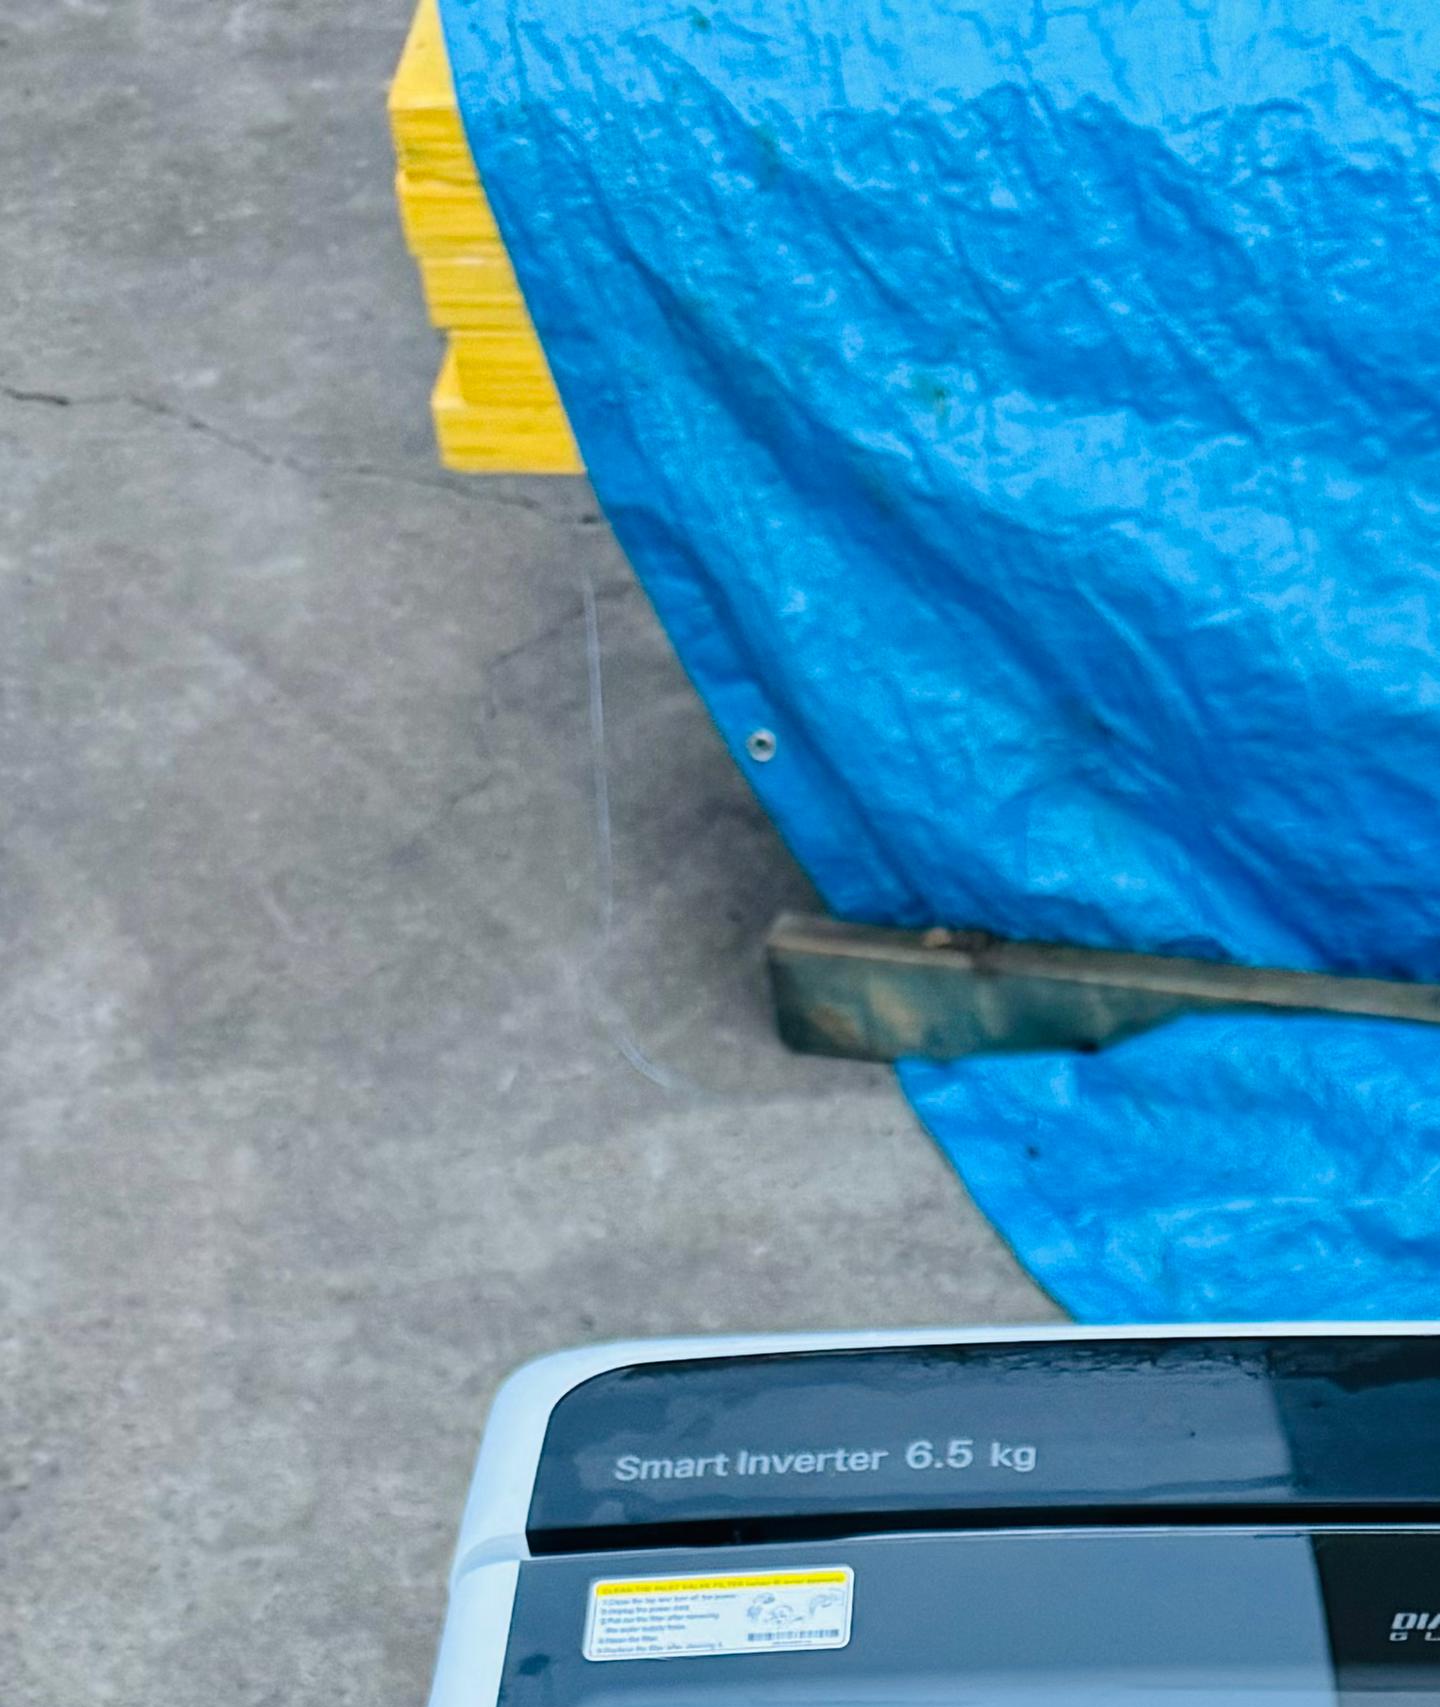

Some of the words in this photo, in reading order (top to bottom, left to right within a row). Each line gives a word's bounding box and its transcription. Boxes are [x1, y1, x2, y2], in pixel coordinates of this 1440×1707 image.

[615, 1451, 726, 1482] Smart
[738, 1446, 889, 1475] Inverter
[906, 1439, 973, 1470] 6.5
[991, 1440, 1038, 1472] kg
